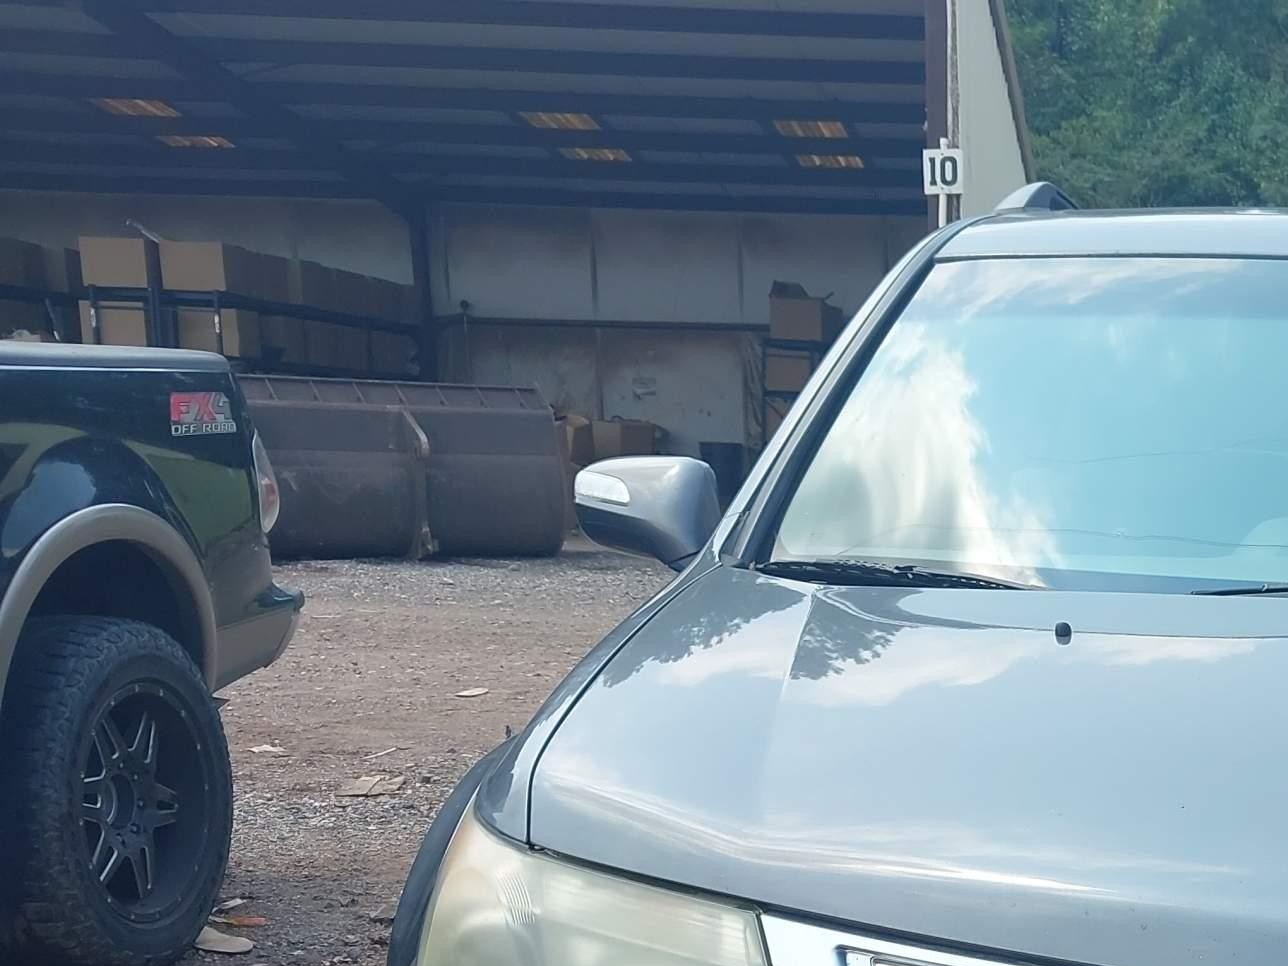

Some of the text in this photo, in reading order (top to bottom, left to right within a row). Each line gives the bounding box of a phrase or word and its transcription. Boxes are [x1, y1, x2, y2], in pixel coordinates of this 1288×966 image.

[928, 156, 958, 186] 10
[170, 392, 232, 422] FX4
[172, 422, 237, 436] OFF ROAD
